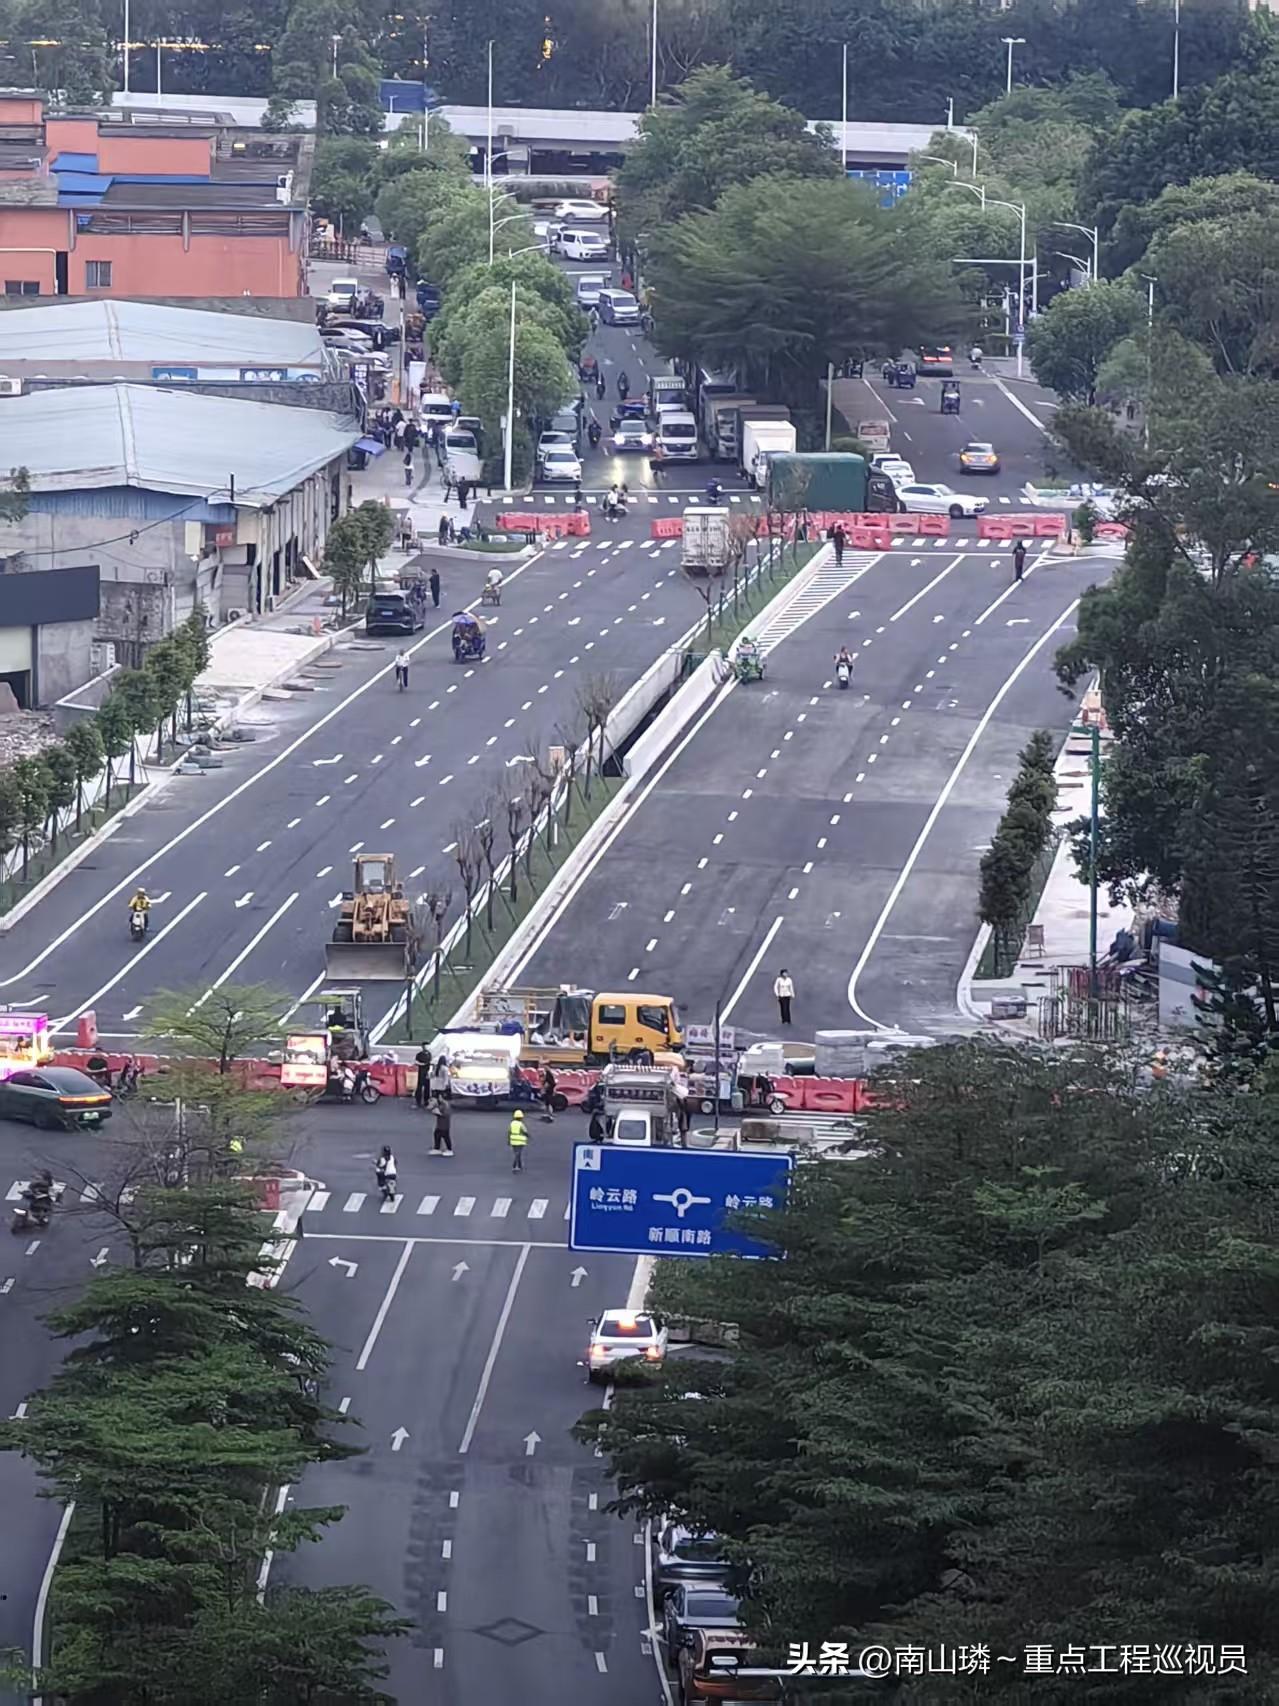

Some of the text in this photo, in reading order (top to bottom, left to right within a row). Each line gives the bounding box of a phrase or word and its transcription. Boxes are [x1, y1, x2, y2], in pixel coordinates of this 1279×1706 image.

[589, 1187, 638, 1205] 岭云路
[648, 1226, 712, 1245] 新顺南路
